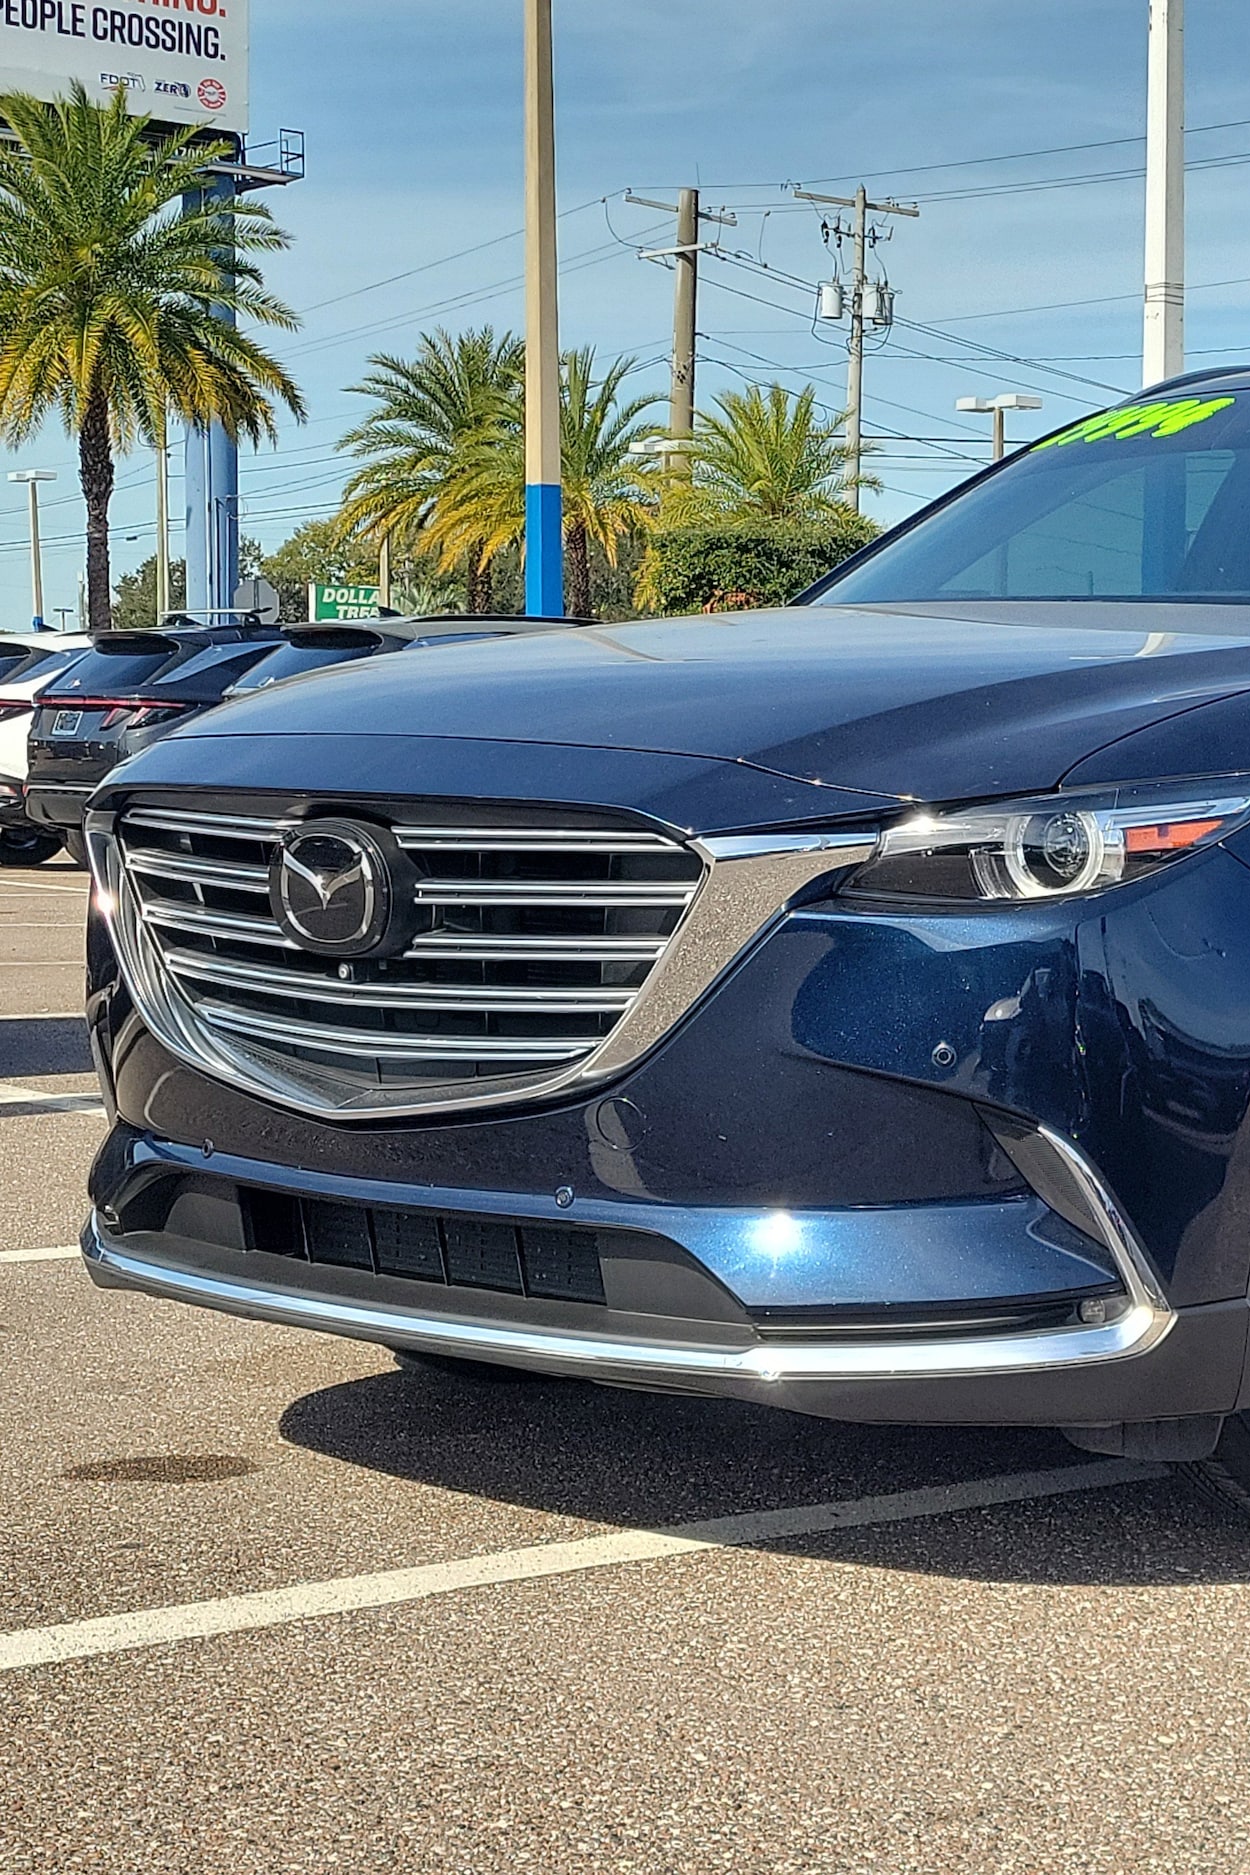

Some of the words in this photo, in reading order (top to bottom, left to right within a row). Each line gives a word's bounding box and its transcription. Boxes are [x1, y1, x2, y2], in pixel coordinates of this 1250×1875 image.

[0, 0, 86, 37] EOPLE
[92, 7, 227, 61] CROSSING.
[100, 73, 138, 89] FDOT
[322, 588, 380, 604] DOLLA
